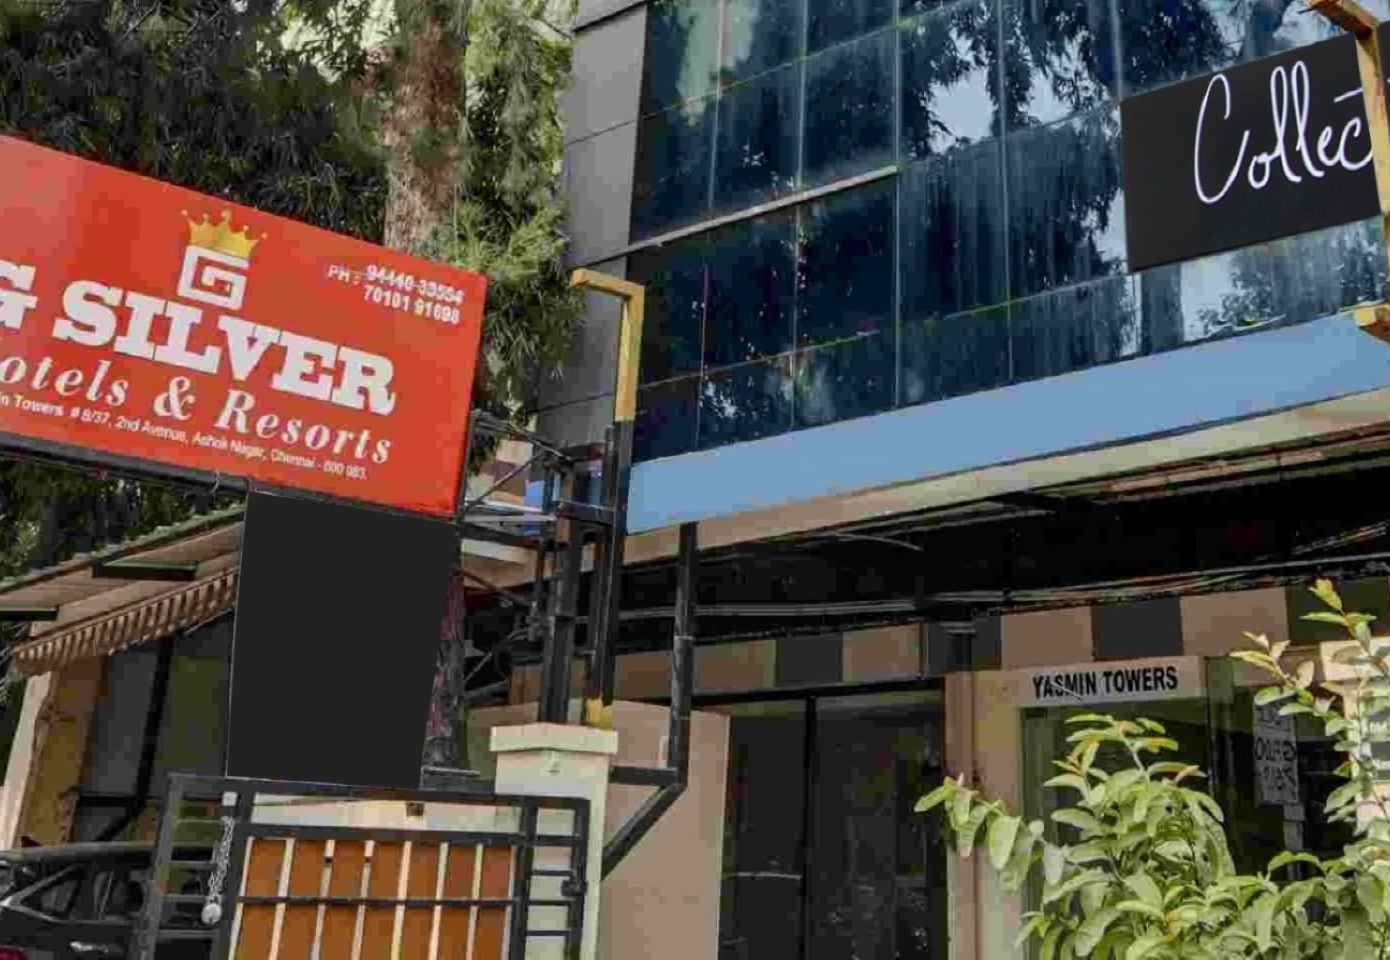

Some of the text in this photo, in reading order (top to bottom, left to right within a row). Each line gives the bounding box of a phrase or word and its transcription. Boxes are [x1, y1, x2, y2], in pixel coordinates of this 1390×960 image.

[52, 279, 396, 416] SILVER
[153, 376, 197, 421] &
[213, 388, 392, 464] Resorts
[1032, 665, 1178, 700] YASMIN TOWERS
